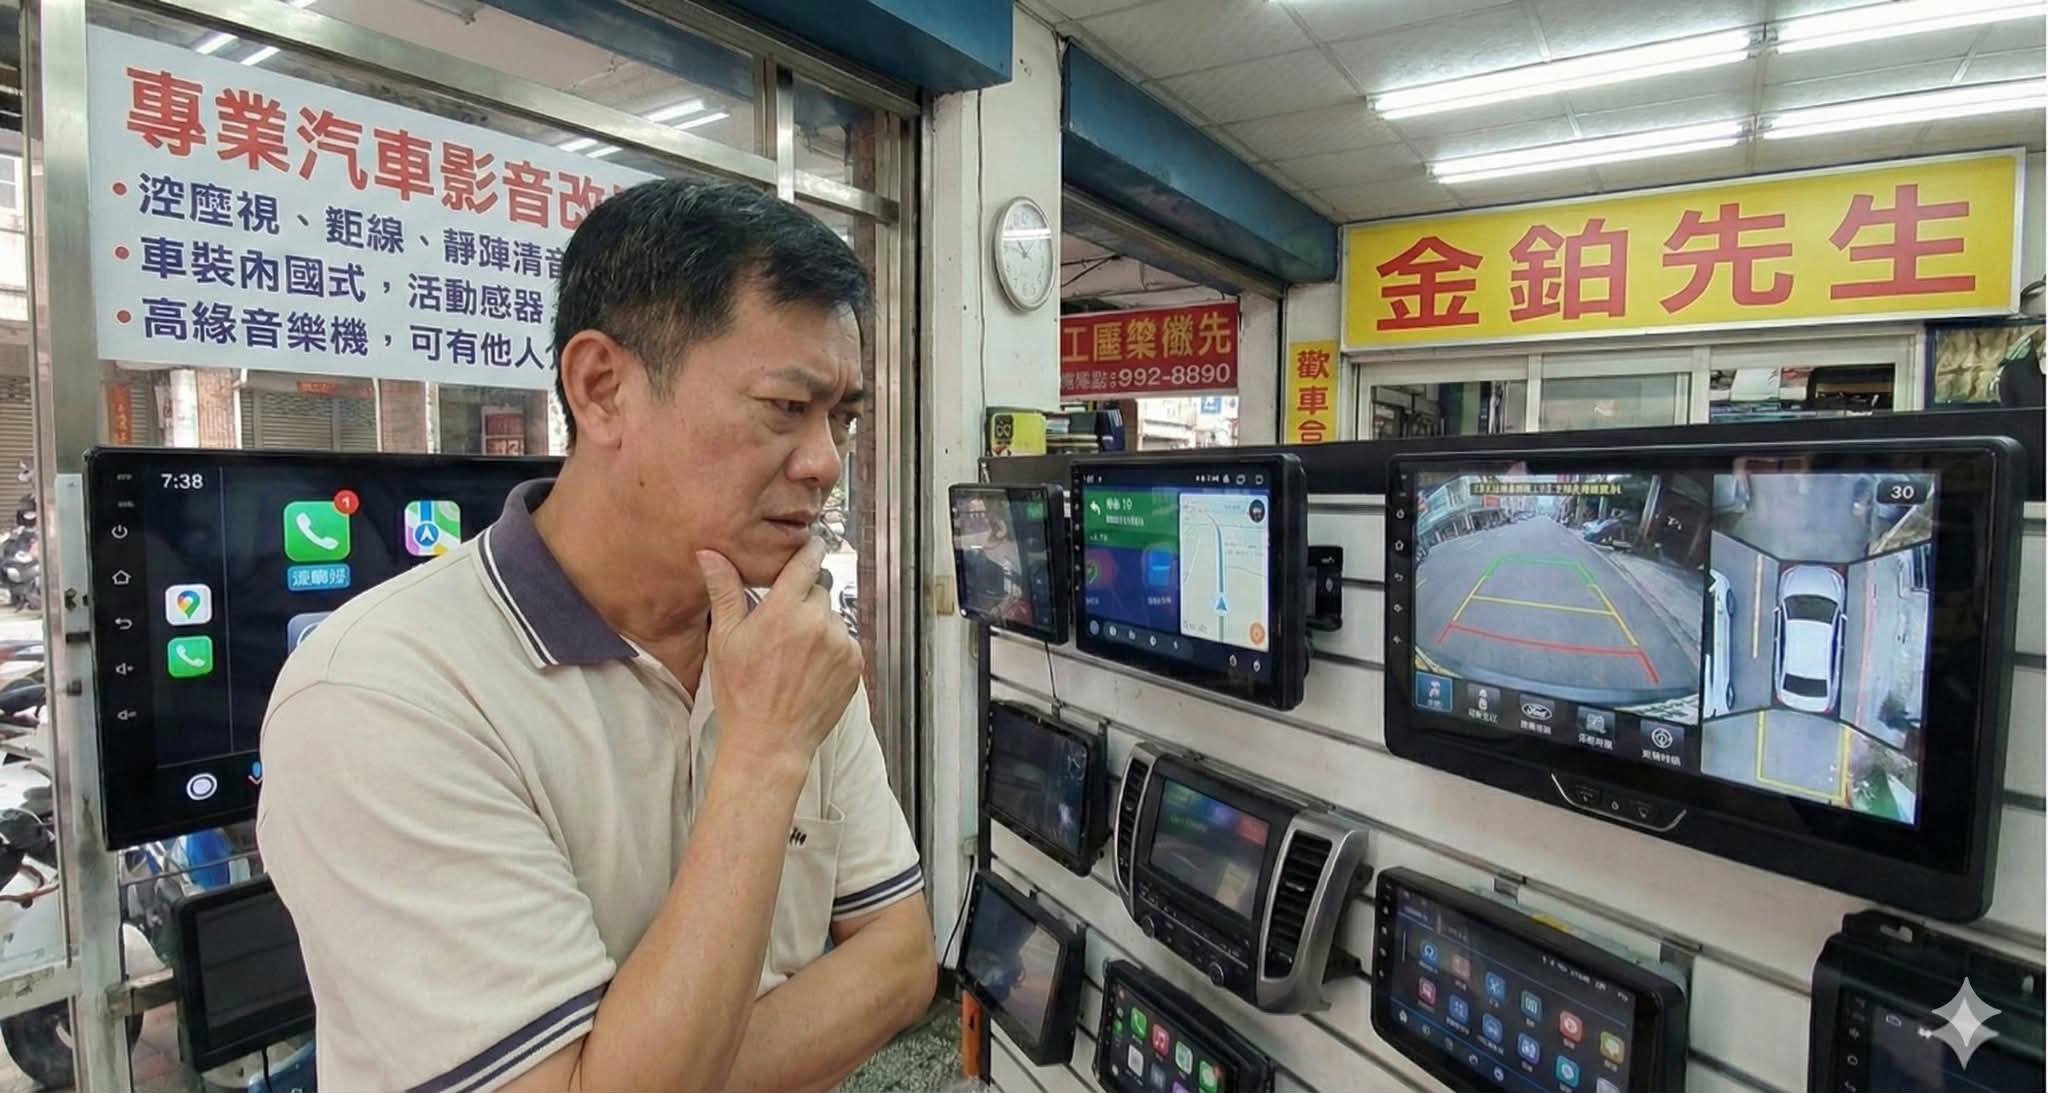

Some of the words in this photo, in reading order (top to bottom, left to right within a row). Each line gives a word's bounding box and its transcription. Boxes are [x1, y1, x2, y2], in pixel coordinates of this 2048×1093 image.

[126, 66, 625, 230] 專業汽車影音改
[1376, 184, 1977, 331] 金鉑先生
[1118, 363, 1231, 388] 992-8890
[161, 473, 204, 489] 7:38
[1890, 485, 1915, 500] 30
